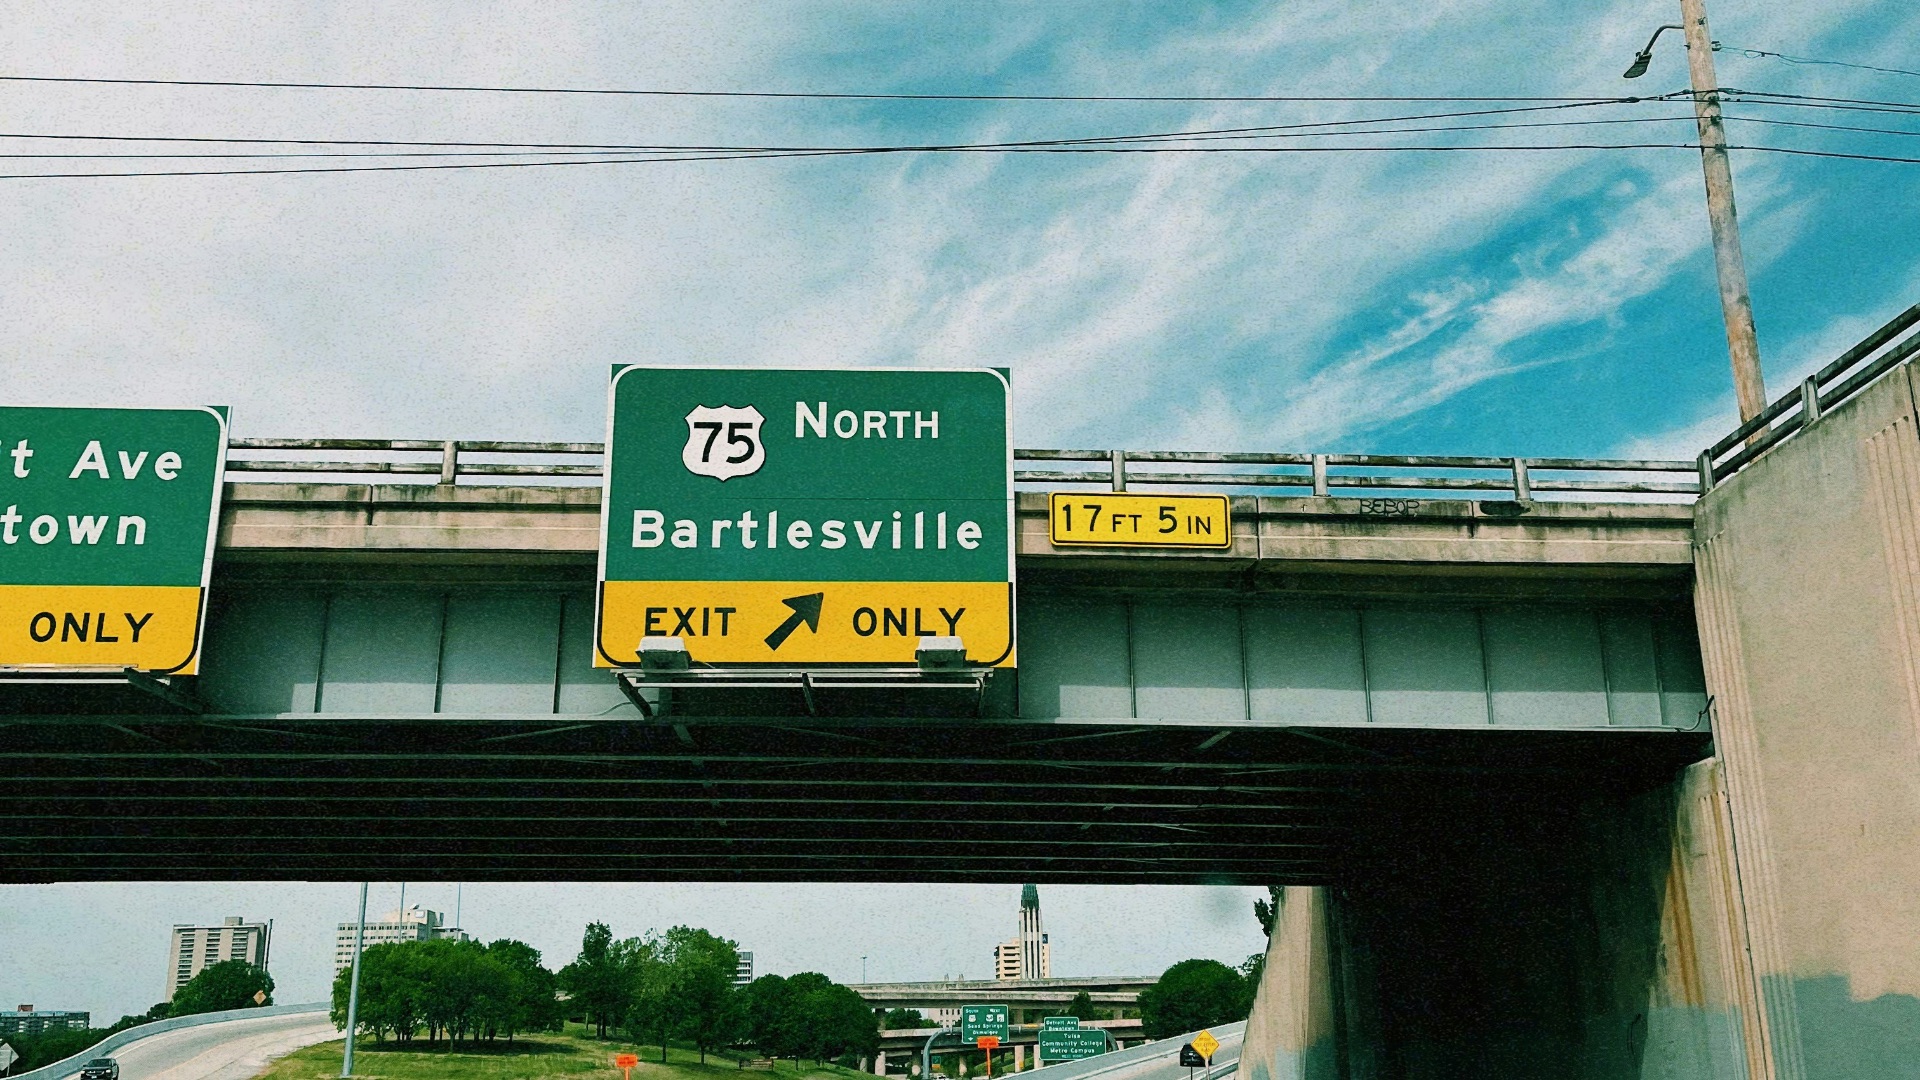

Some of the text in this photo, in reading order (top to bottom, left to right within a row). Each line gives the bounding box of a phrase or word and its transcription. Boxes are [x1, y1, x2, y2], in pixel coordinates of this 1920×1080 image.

[795, 401, 939, 439] NORTH
[0, 438, 183, 480] t Ave
[693, 421, 756, 464] 75
[632, 510, 983, 550] Bartlesville
[1062, 504, 1212, 535] 17 FT 5 IN
[29, 611, 154, 643] ONLY
[644, 607, 966, 637] EXIT ONLY
